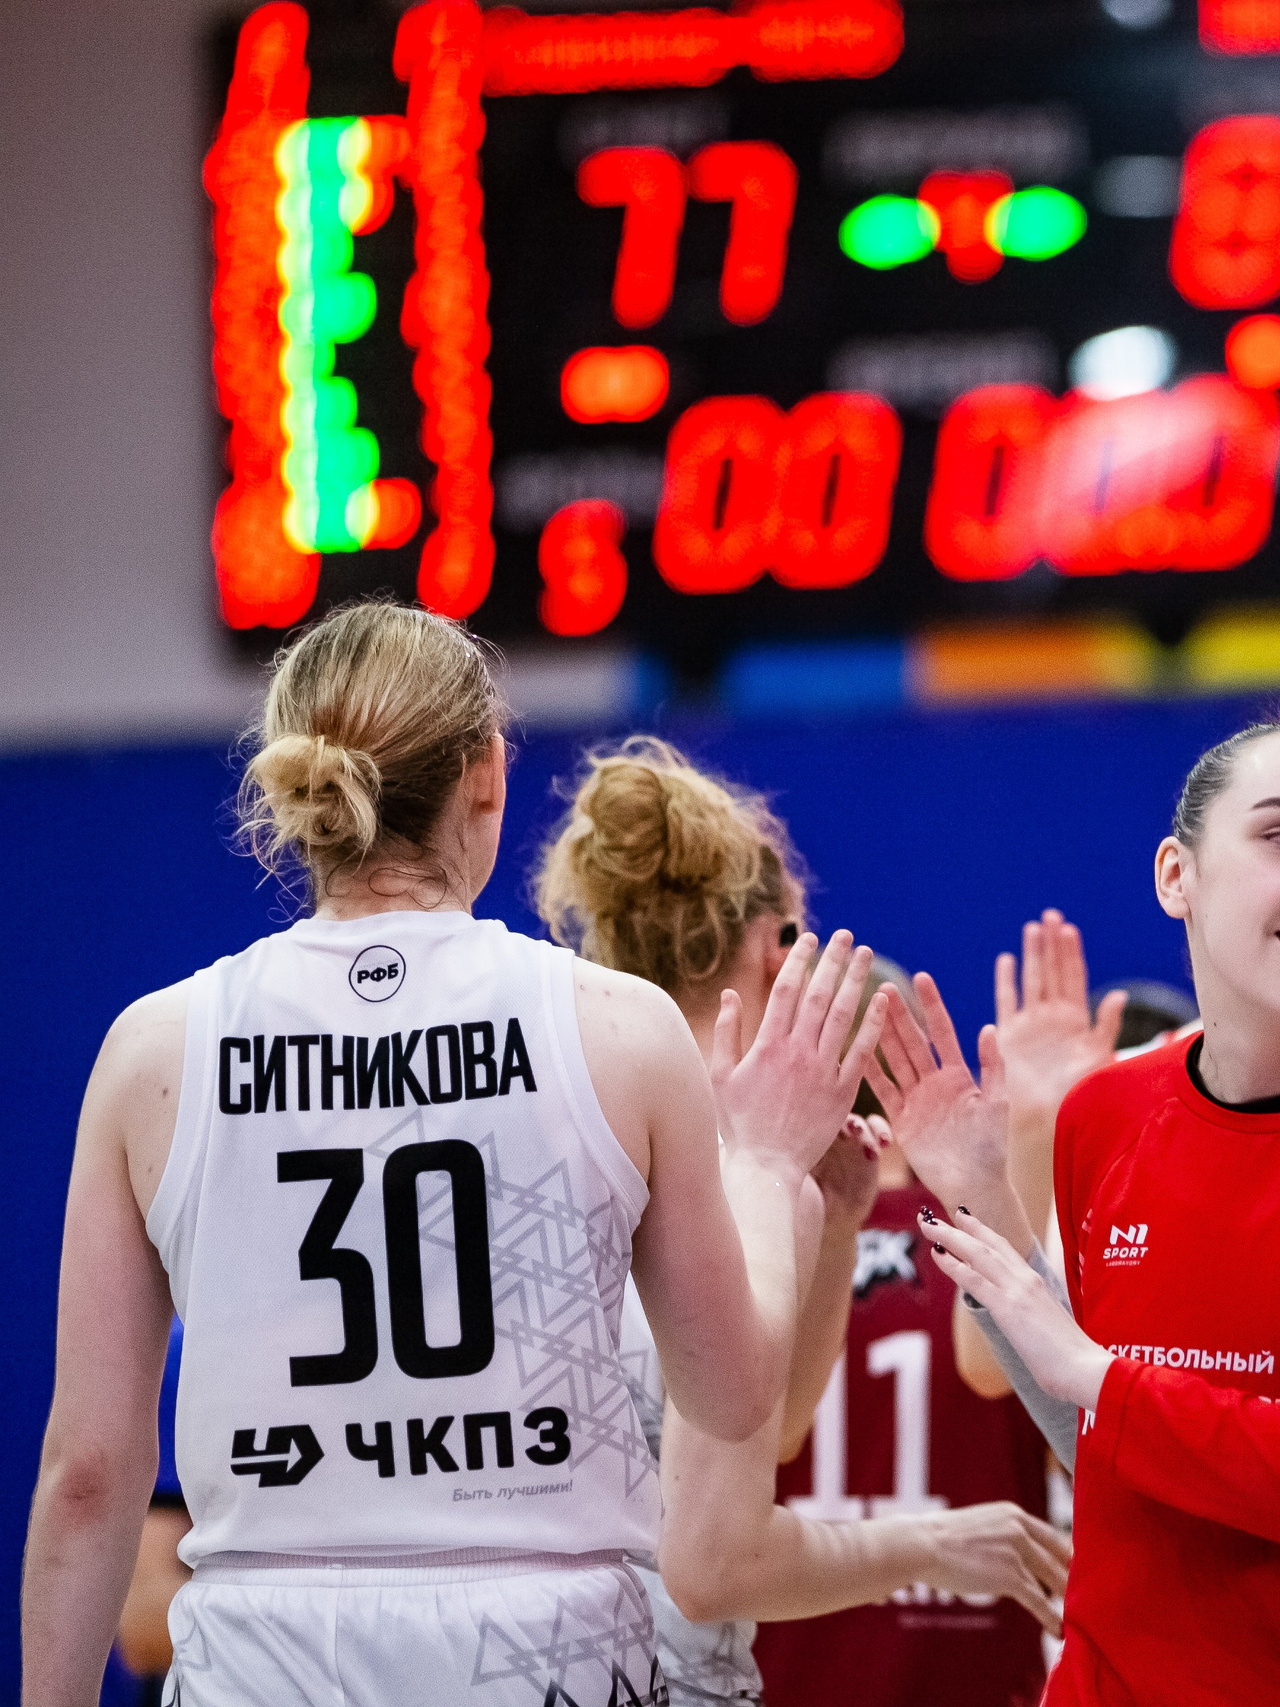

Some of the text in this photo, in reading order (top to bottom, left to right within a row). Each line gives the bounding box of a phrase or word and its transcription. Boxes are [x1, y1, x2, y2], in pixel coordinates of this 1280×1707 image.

[578, 141, 797, 328] 77
[357, 963, 399, 984] РФБ
[218, 1017, 538, 1116] СИТНИКОВА
[277, 1138, 496, 1387] 30
[1102, 1246, 1149, 1260] SPORT
[1101, 1344, 1275, 1375] СКЕТБОЛЬНЫЙ
[345, 1406, 572, 1479] ЧКПЗ
[453, 1479, 573, 1501] Быть лучшими!
